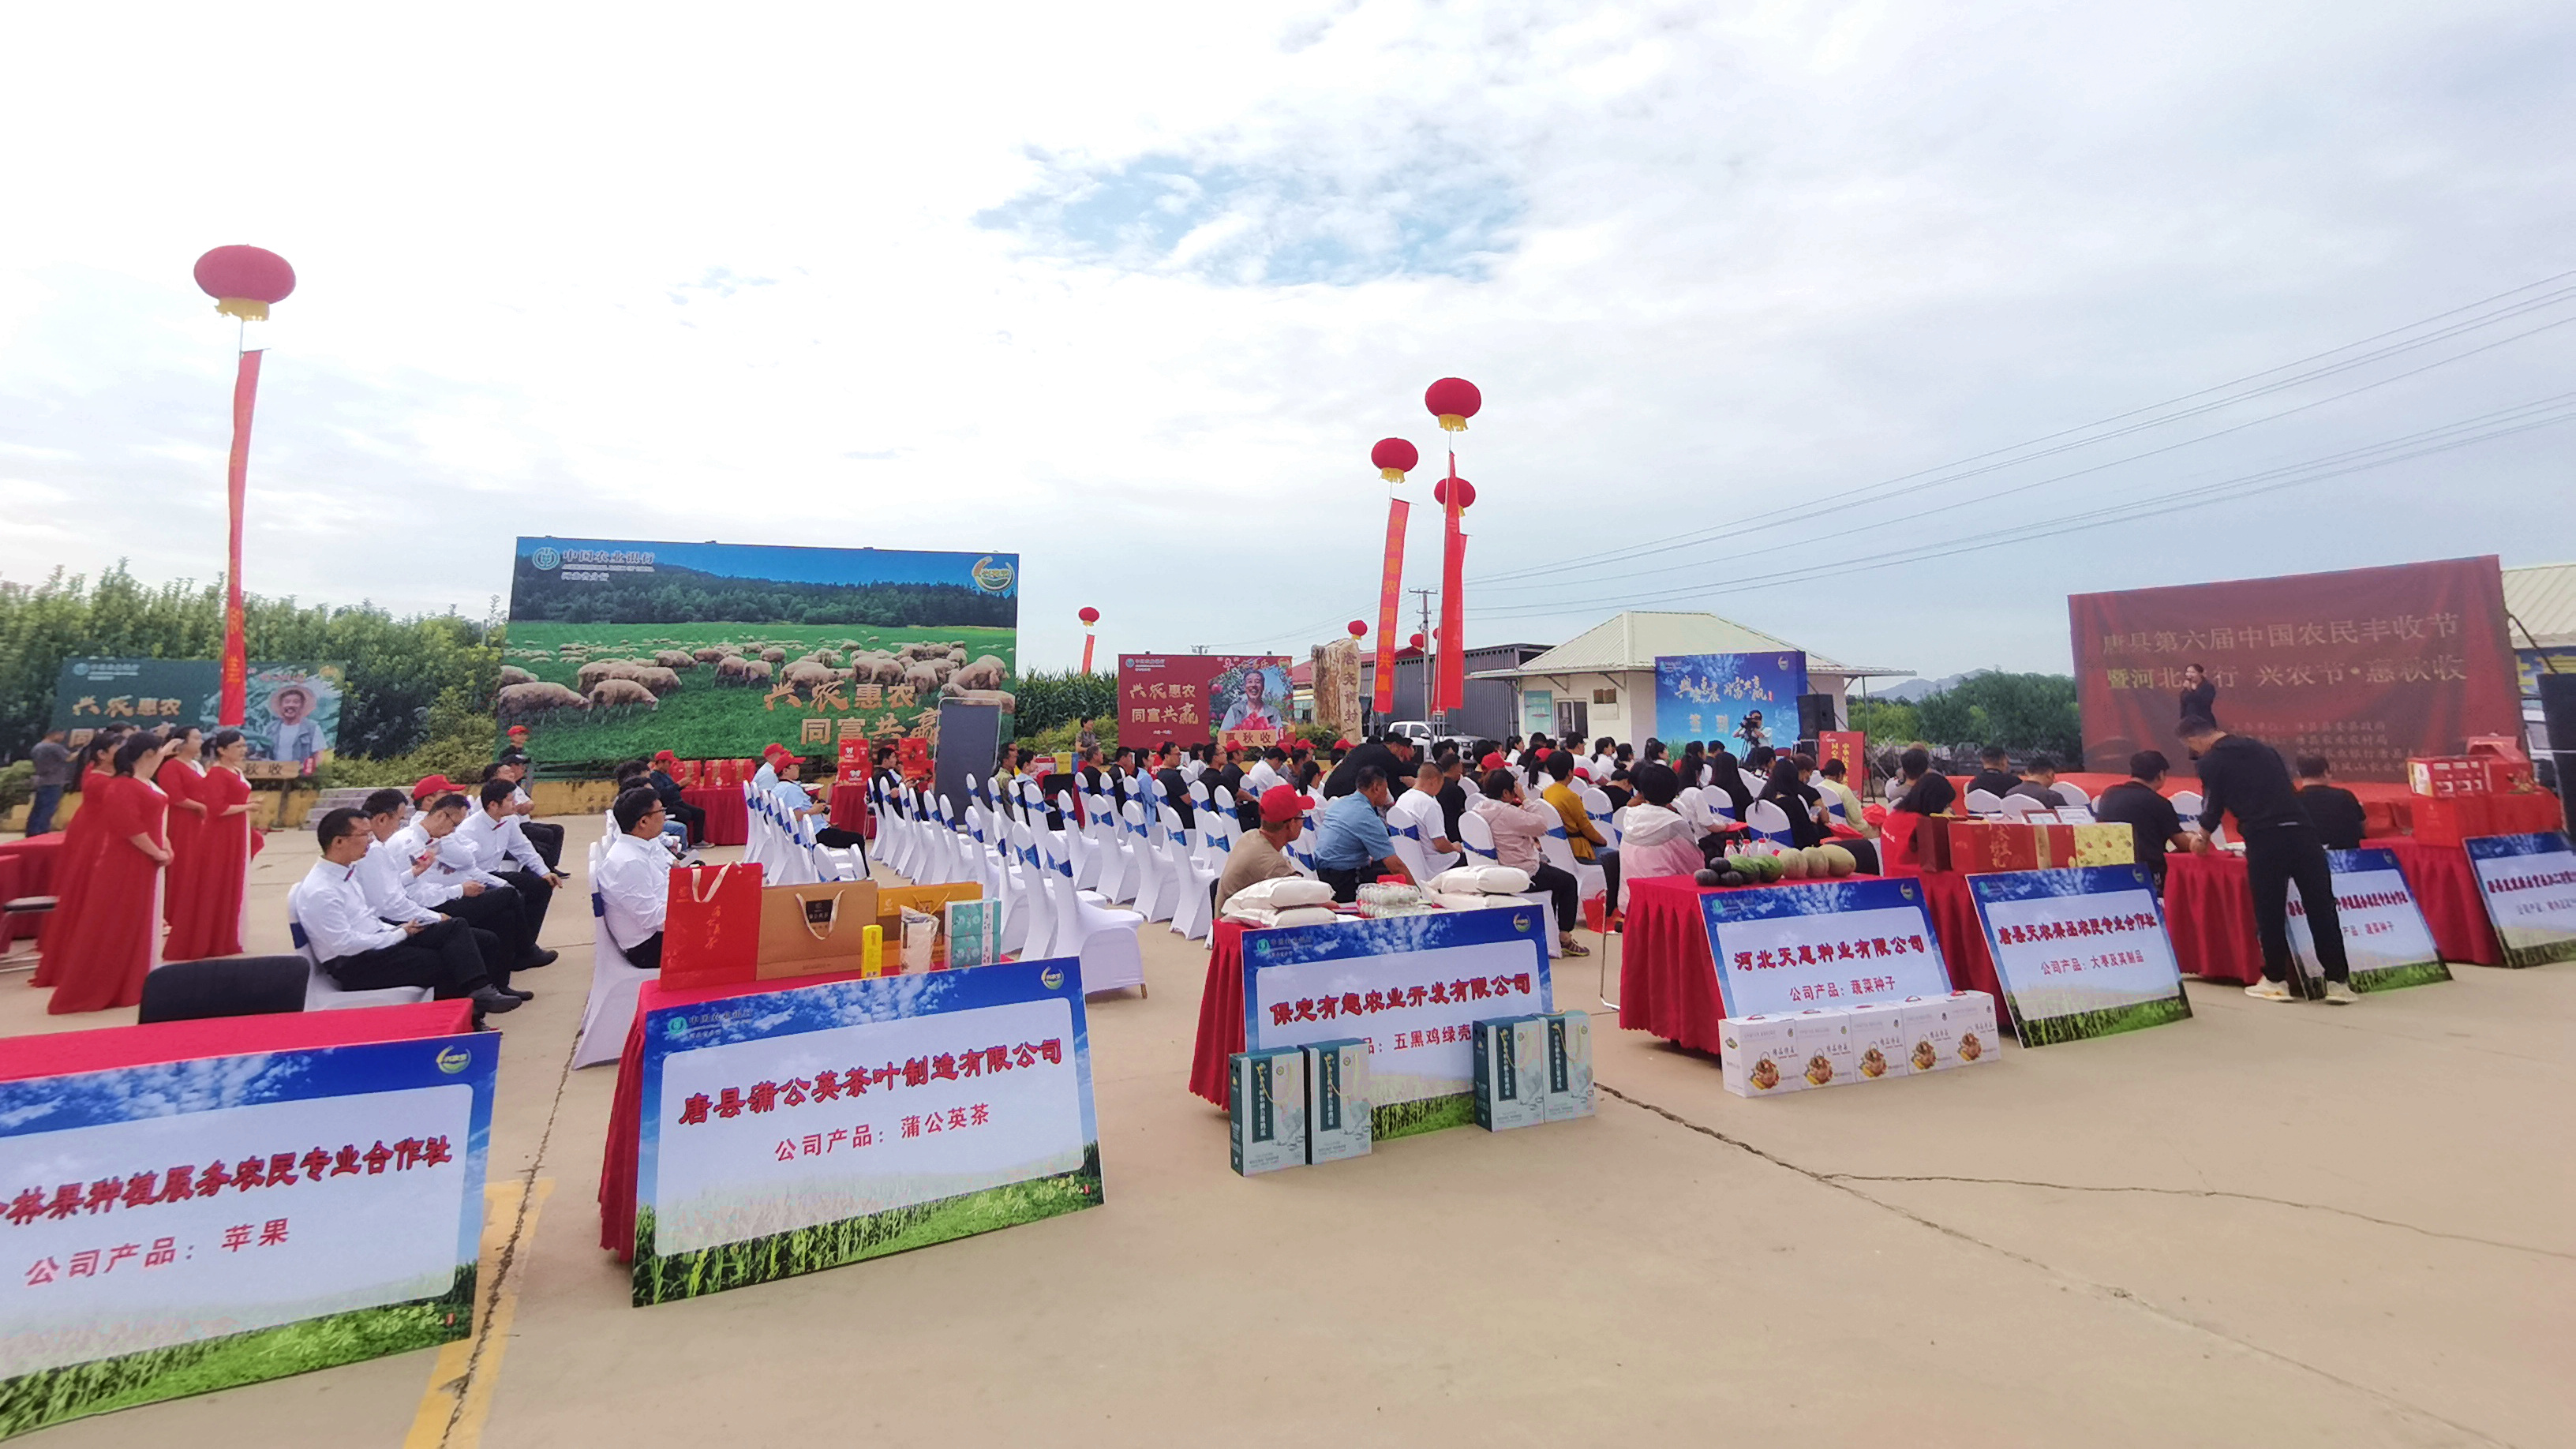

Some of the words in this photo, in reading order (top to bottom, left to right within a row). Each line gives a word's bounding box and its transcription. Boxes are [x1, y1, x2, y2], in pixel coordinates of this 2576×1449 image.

[2103, 612, 2459, 656] 唐县第六届中国农民丰收节
[1129, 683, 1196, 700] 兴农惠农
[2106, 665, 2238, 690] 暨河北行
[763, 680, 915, 712] 兴农惠农
[1132, 702, 1199, 724] 同富共赢
[800, 707, 942, 747] 同富共赢
[1790, 976, 1895, 1002] 公司产品：蔬菜种子
[679, 1038, 1061, 1126] 唐县蒲公英茶叶制造有限公司
[774, 1103, 990, 1162] 公司产品：蒲公英茶
[25, 1218, 290, 1286] 公司产品：苹果
